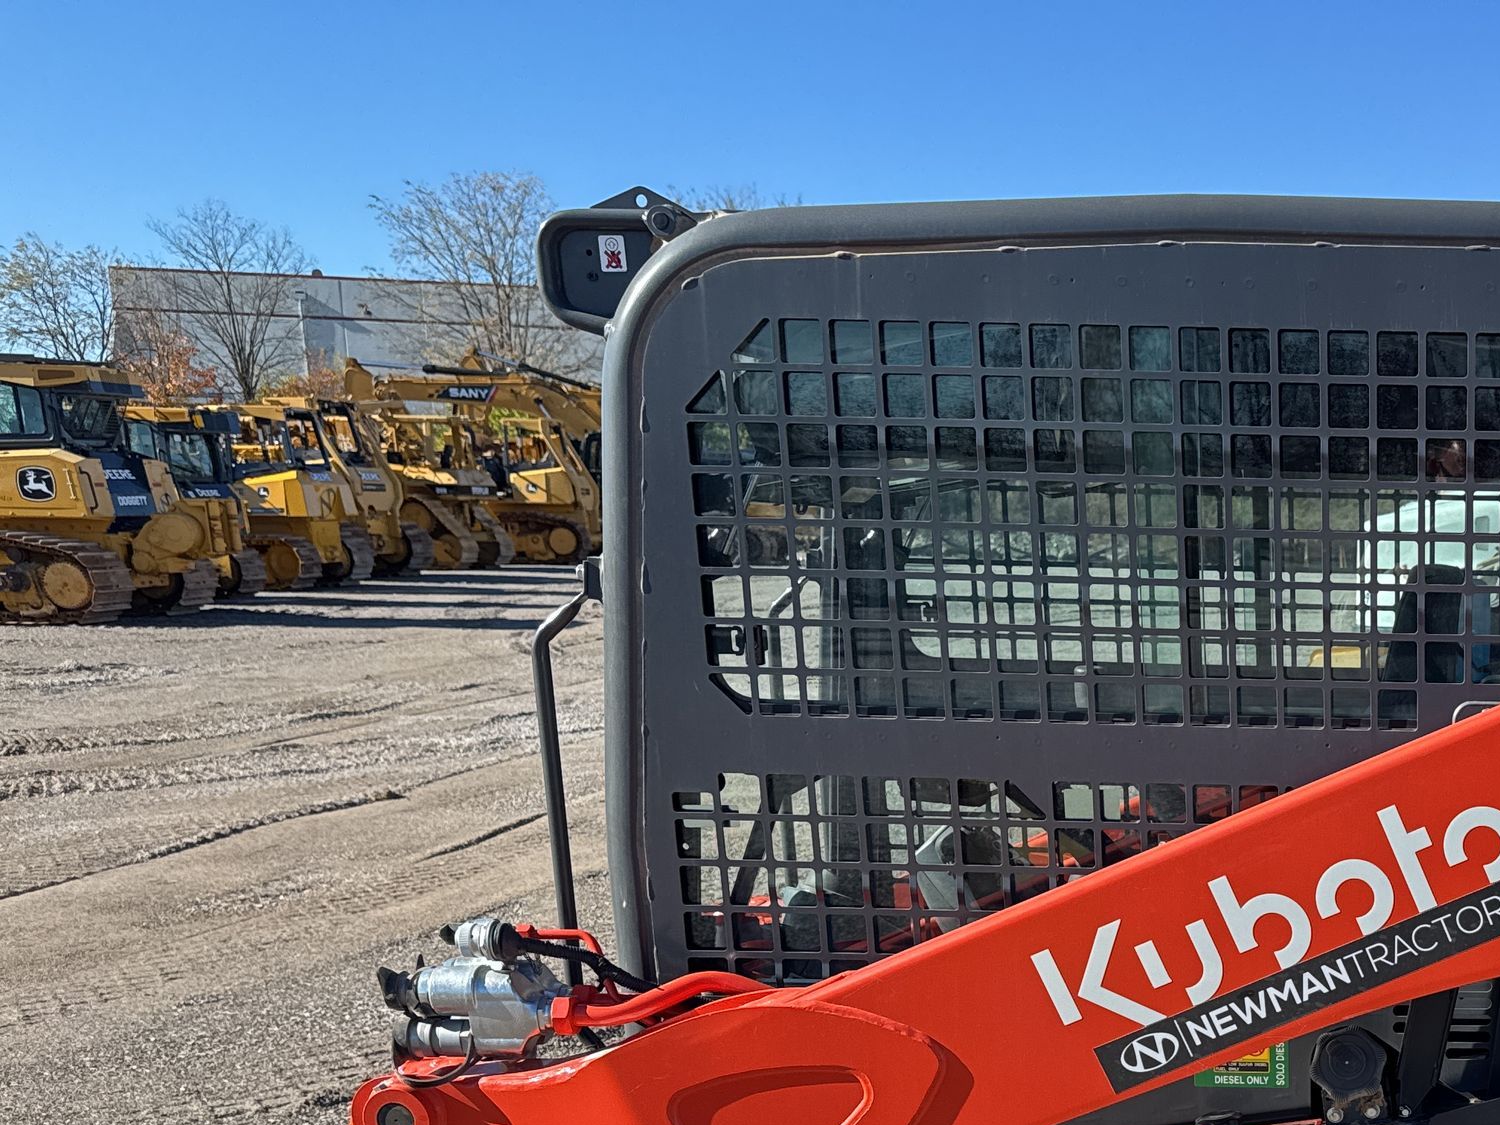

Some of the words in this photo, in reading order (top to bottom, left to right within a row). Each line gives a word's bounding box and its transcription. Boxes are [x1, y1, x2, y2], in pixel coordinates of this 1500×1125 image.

[449, 386, 488, 399] SANY
[1275, 1042, 1285, 1062] DIES
[1214, 1075, 1245, 1085] DIESEL
[1246, 1076, 1269, 1085] ONLY
[1275, 1063, 1285, 1086] SOLO
